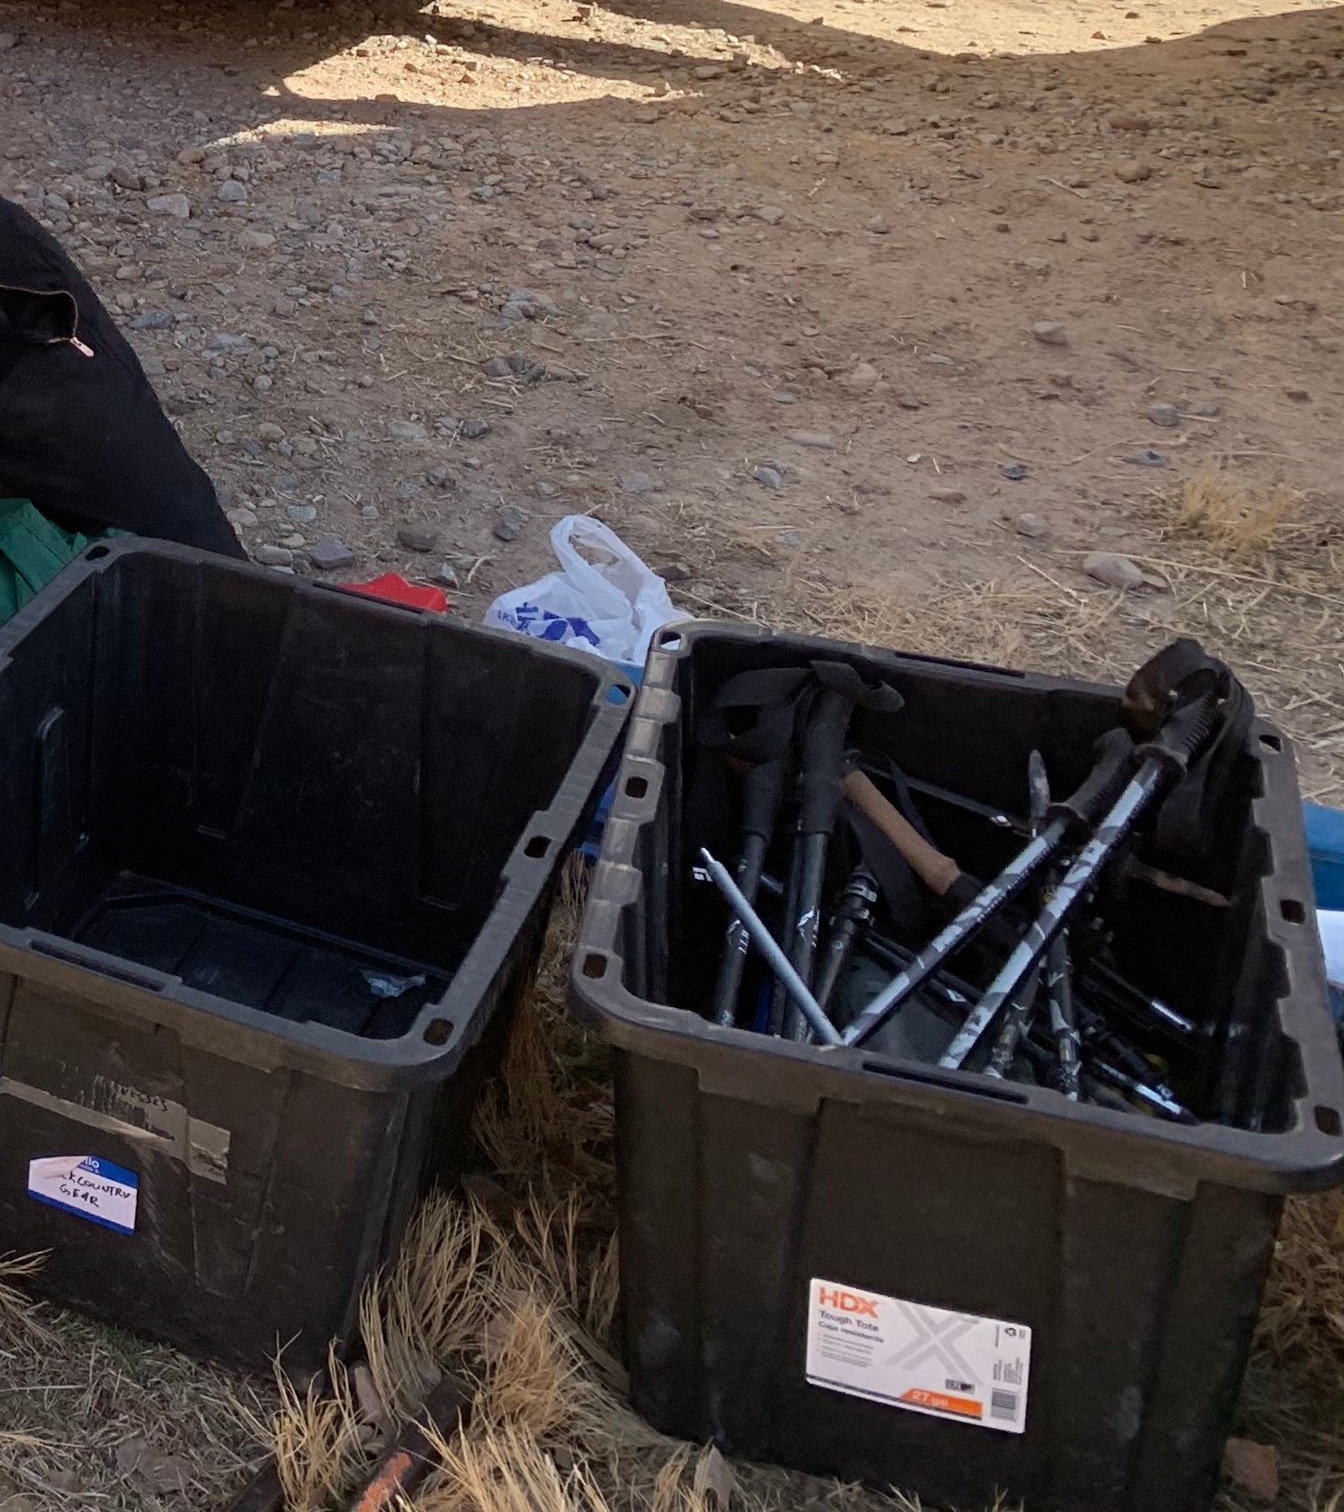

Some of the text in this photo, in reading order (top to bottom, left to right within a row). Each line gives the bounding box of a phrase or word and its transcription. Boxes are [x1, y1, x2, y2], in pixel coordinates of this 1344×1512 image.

[59, 1183, 100, 1209] GEAR
[819, 1286, 880, 1320] HDX
[819, 1310, 880, 1332] Tough Tote
